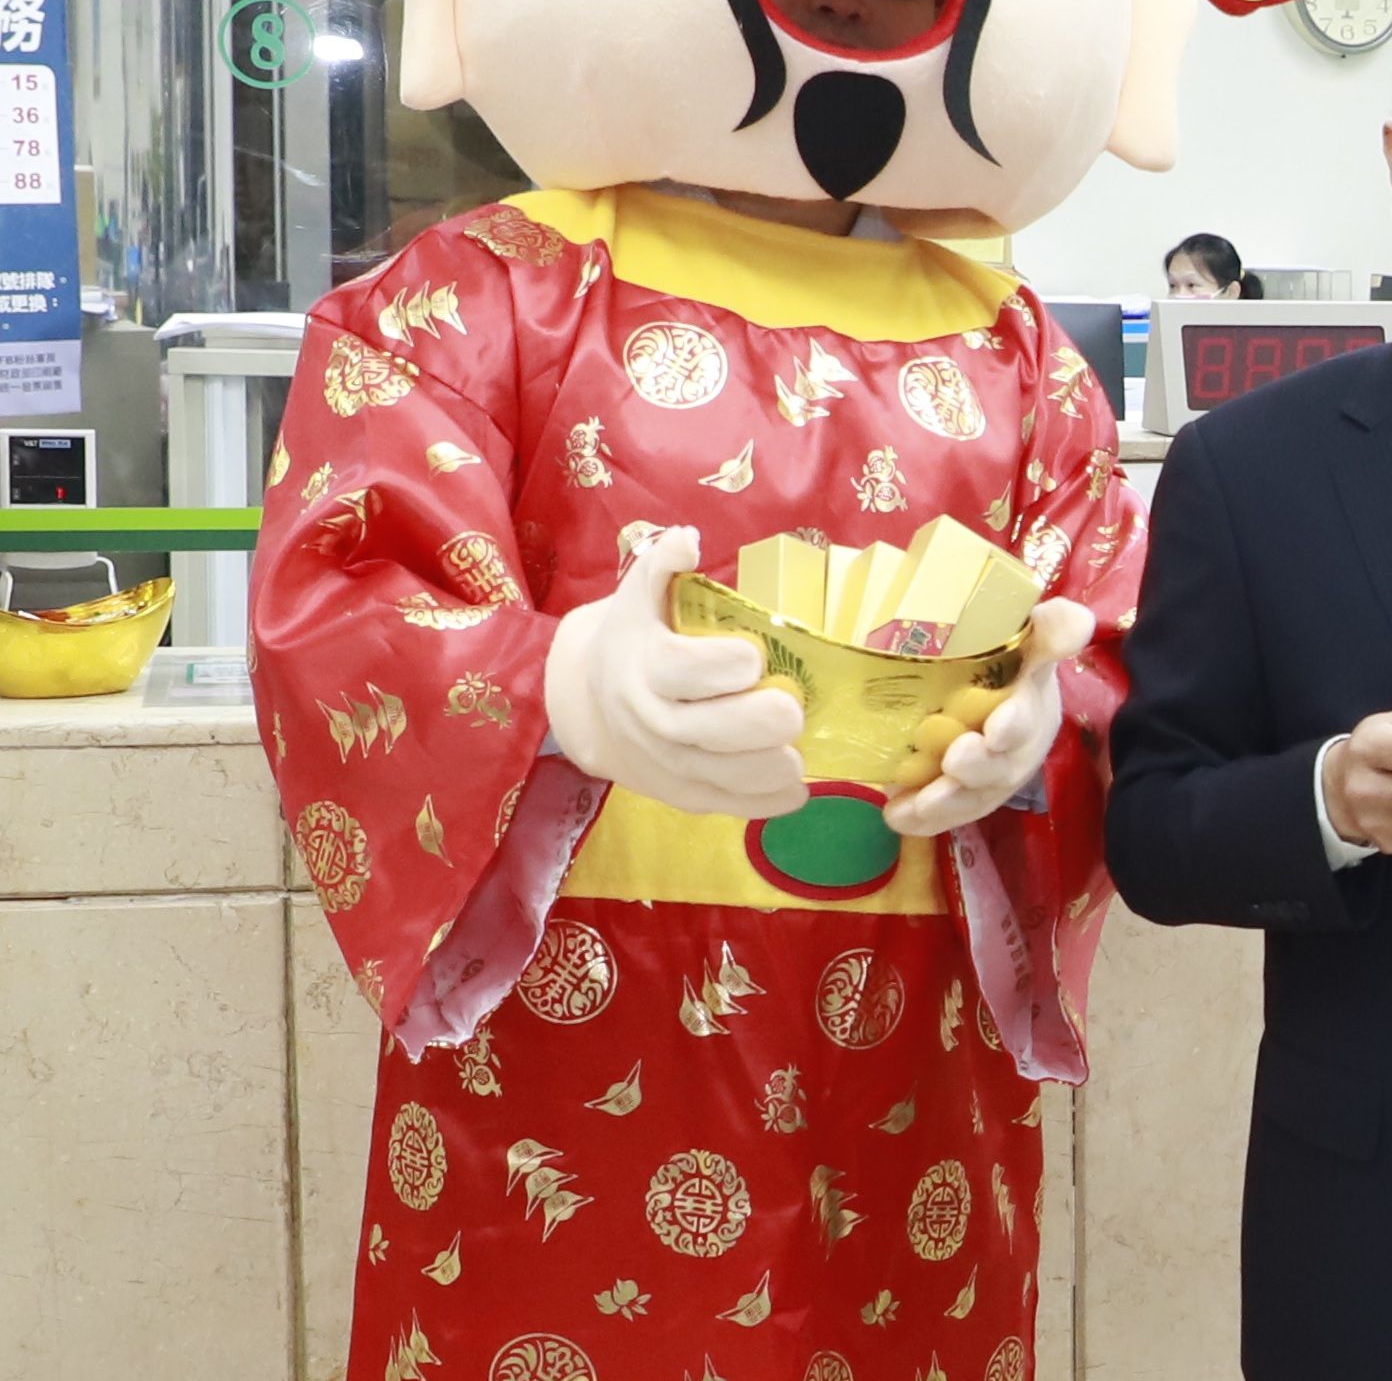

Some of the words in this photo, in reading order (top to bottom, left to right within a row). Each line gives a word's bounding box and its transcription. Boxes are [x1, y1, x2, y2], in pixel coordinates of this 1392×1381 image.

[1340, 24, 1355, 40] 6
[1363, 20, 1377, 36] 5
[250, 13, 285, 70] 8
[12, 74, 38, 91] 15
[12, 107, 39, 124] 36
[13, 140, 41, 157] 78
[14, 173, 42, 190] 88
